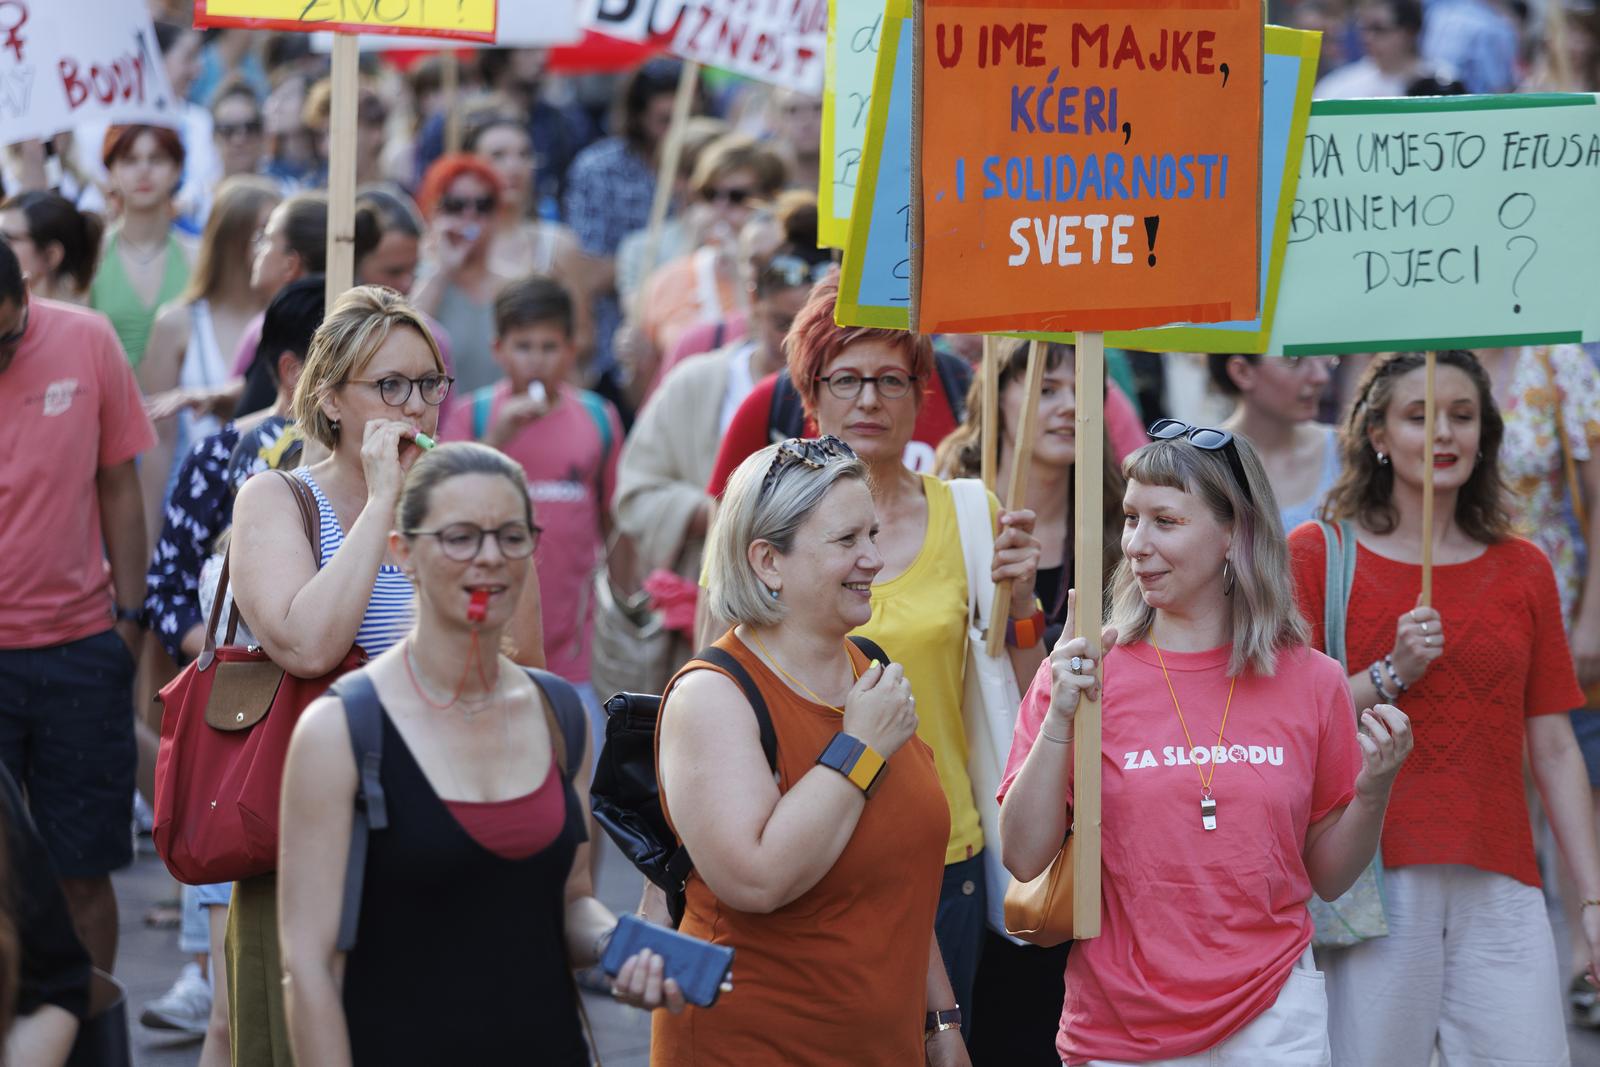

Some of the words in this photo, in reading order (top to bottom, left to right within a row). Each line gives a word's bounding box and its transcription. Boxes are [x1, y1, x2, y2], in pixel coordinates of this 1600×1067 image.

[935, 23, 963, 69] U
[977, 23, 1048, 69] IME
[1071, 23, 1230, 88] MAJKE,
[1010, 66, 1132, 145] KĆERI,
[955, 157, 965, 203] I
[982, 152, 1229, 202] SOLIDARNOSTI
[1304, 132, 1344, 178] DA
[1356, 131, 1486, 176] UMJESTO
[1502, 131, 1600, 171] FETUSA
[1286, 194, 1455, 244] BRINEMO
[1498, 192, 1537, 231] O
[1123, 749, 1160, 770] ZA
[1162, 744, 1285, 767] SLOBODU
